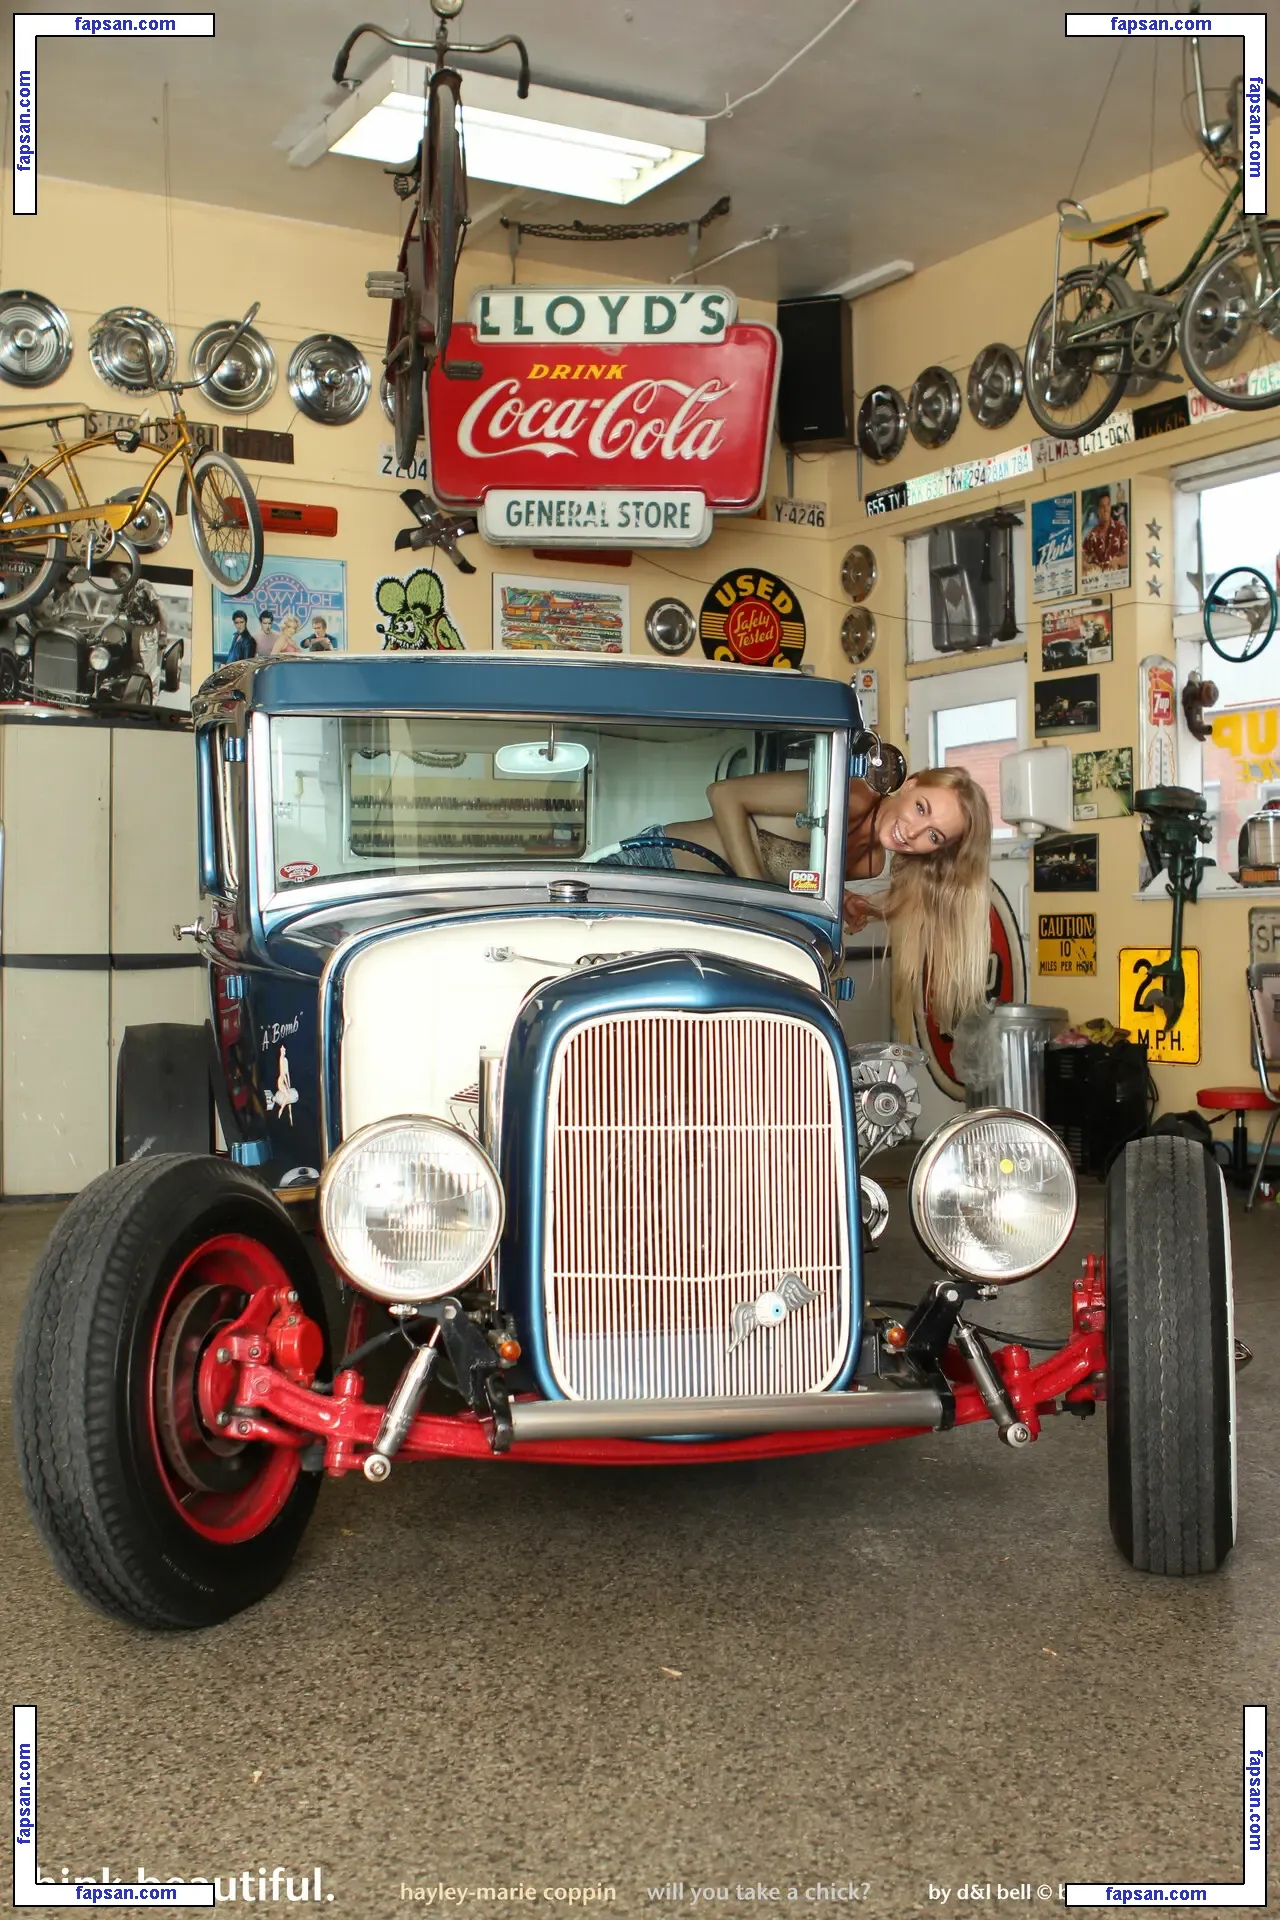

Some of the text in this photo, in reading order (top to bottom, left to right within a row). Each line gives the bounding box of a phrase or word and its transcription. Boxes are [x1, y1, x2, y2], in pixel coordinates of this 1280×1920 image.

[480, 292, 726, 336] LLOYD'S
[527, 364, 628, 380] DRINK
[457, 378, 737, 460] Coca-Cola
[505, 500, 691, 529] GENERAL STORE
[714, 574, 793, 614] USED
[734, 609, 770, 633] Safety
[737, 626, 774, 648] Tested
[793, 872, 815, 882] ROD
[1040, 916, 1093, 937] CAUTION
[1060, 940, 1071, 957] 10
[1040, 960, 1057, 972] MILES
[1060, 961, 1073, 972] PER
[1137, 1028, 1185, 1051] M.P.H.
